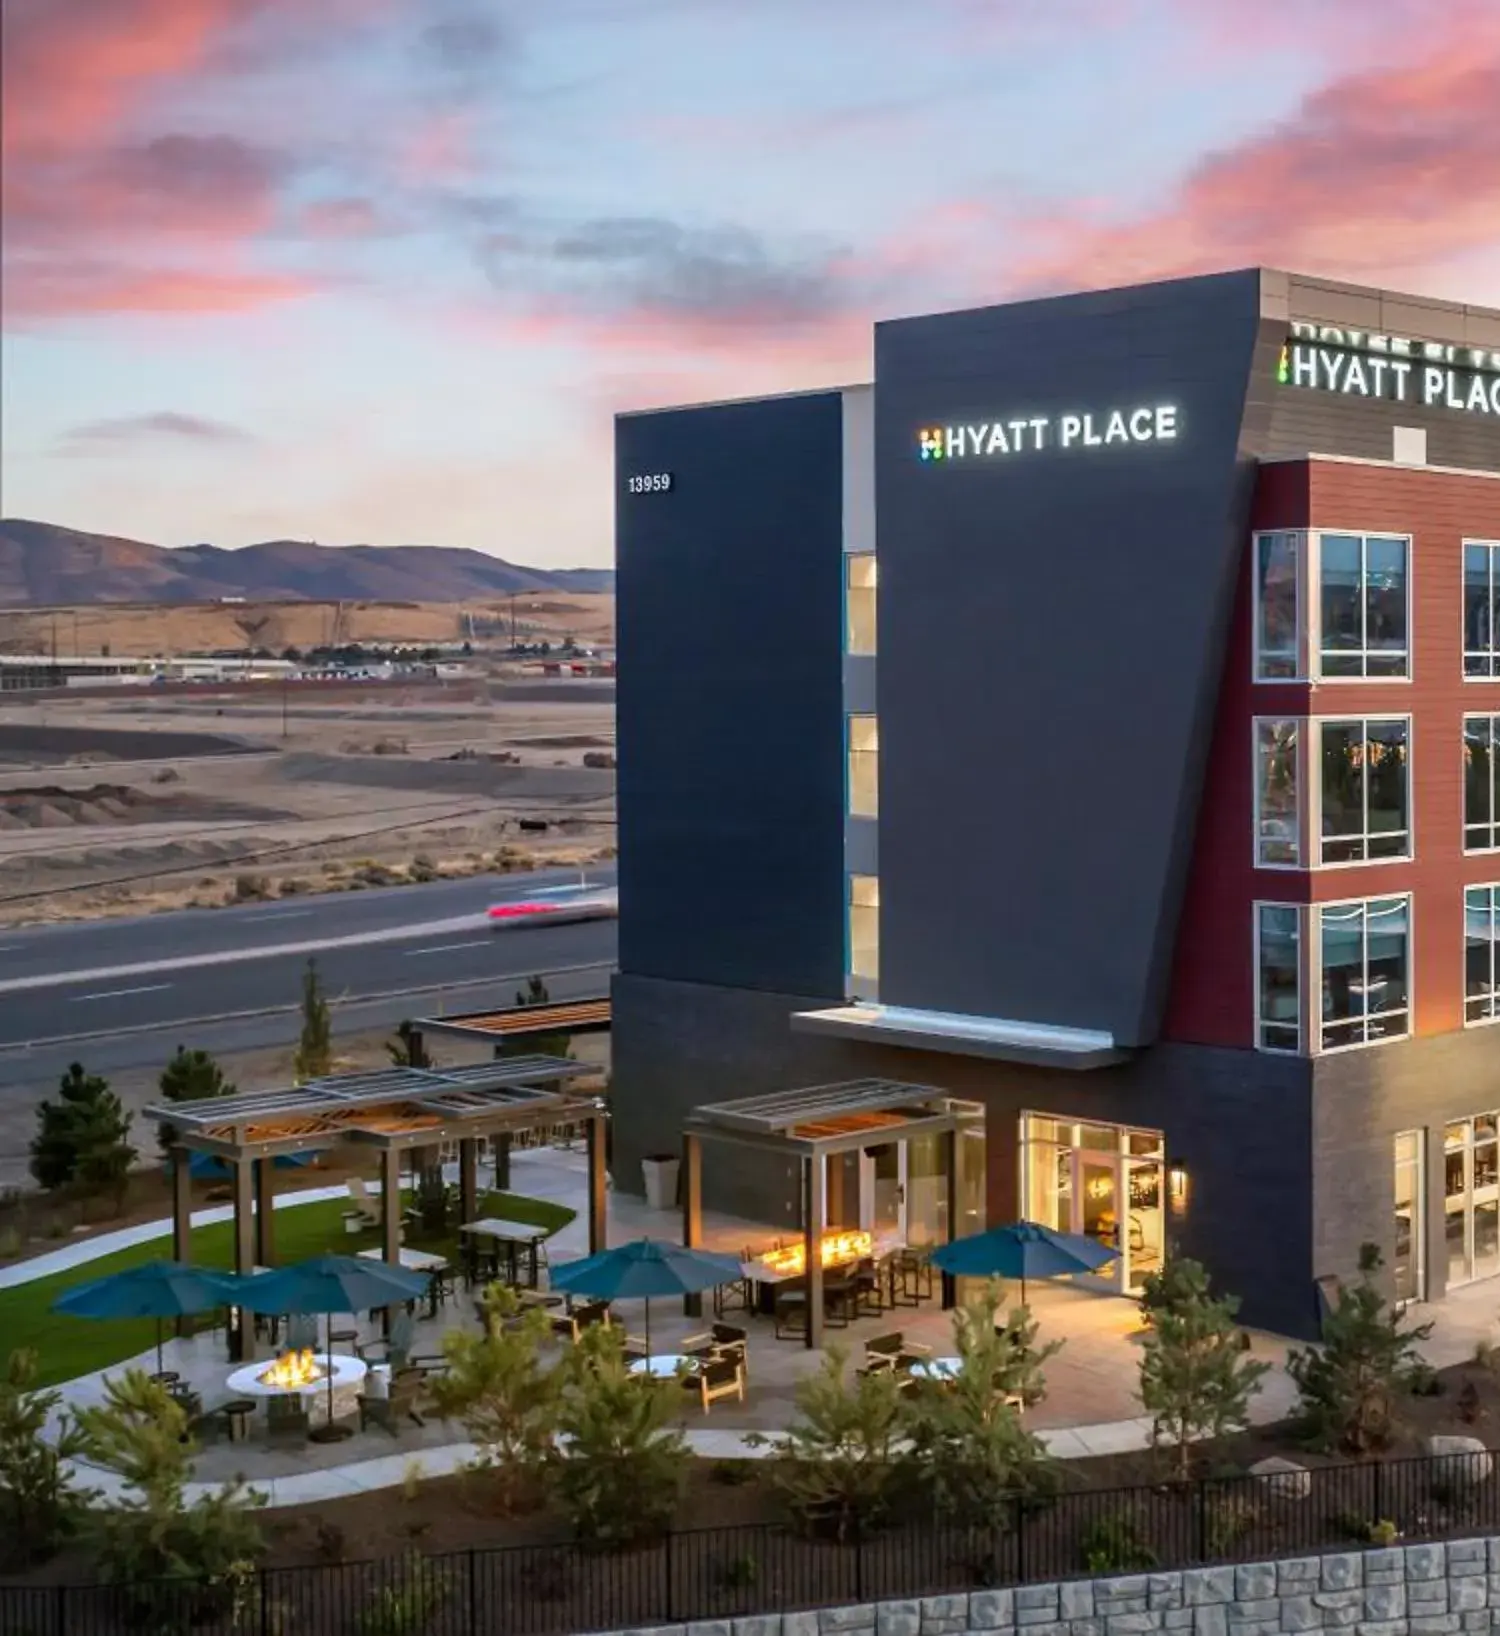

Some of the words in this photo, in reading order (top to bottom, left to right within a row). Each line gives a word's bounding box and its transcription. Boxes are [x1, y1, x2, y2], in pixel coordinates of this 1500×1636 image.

[1293, 346, 1411, 400] HYATT
[946, 418, 1049, 457] HYATT
[1061, 406, 1178, 447] PLACE
[628, 473, 671, 493] 13959
